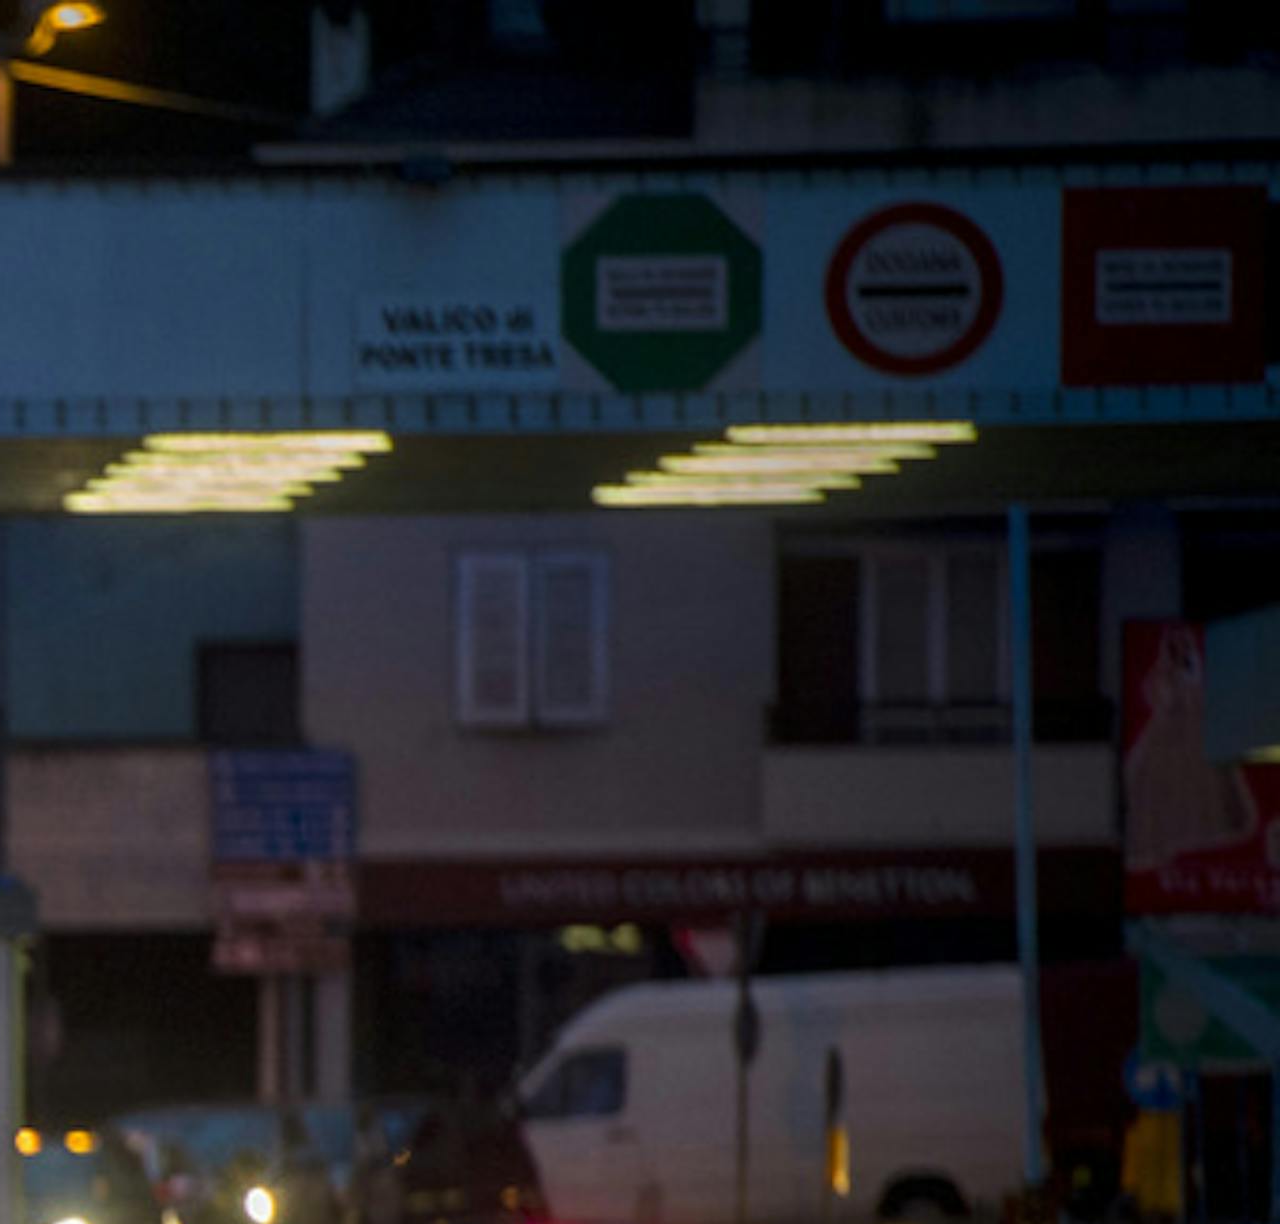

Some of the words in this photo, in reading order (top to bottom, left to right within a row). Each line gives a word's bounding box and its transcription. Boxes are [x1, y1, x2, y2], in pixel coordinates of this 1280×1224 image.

[864, 247, 961, 273] DOGANA
[381, 305, 497, 333] VALICO
[504, 304, 534, 332] di
[359, 342, 453, 369] PONTE
[463, 341, 556, 369] TRESA
[801, 866, 978, 902] BENETTON
